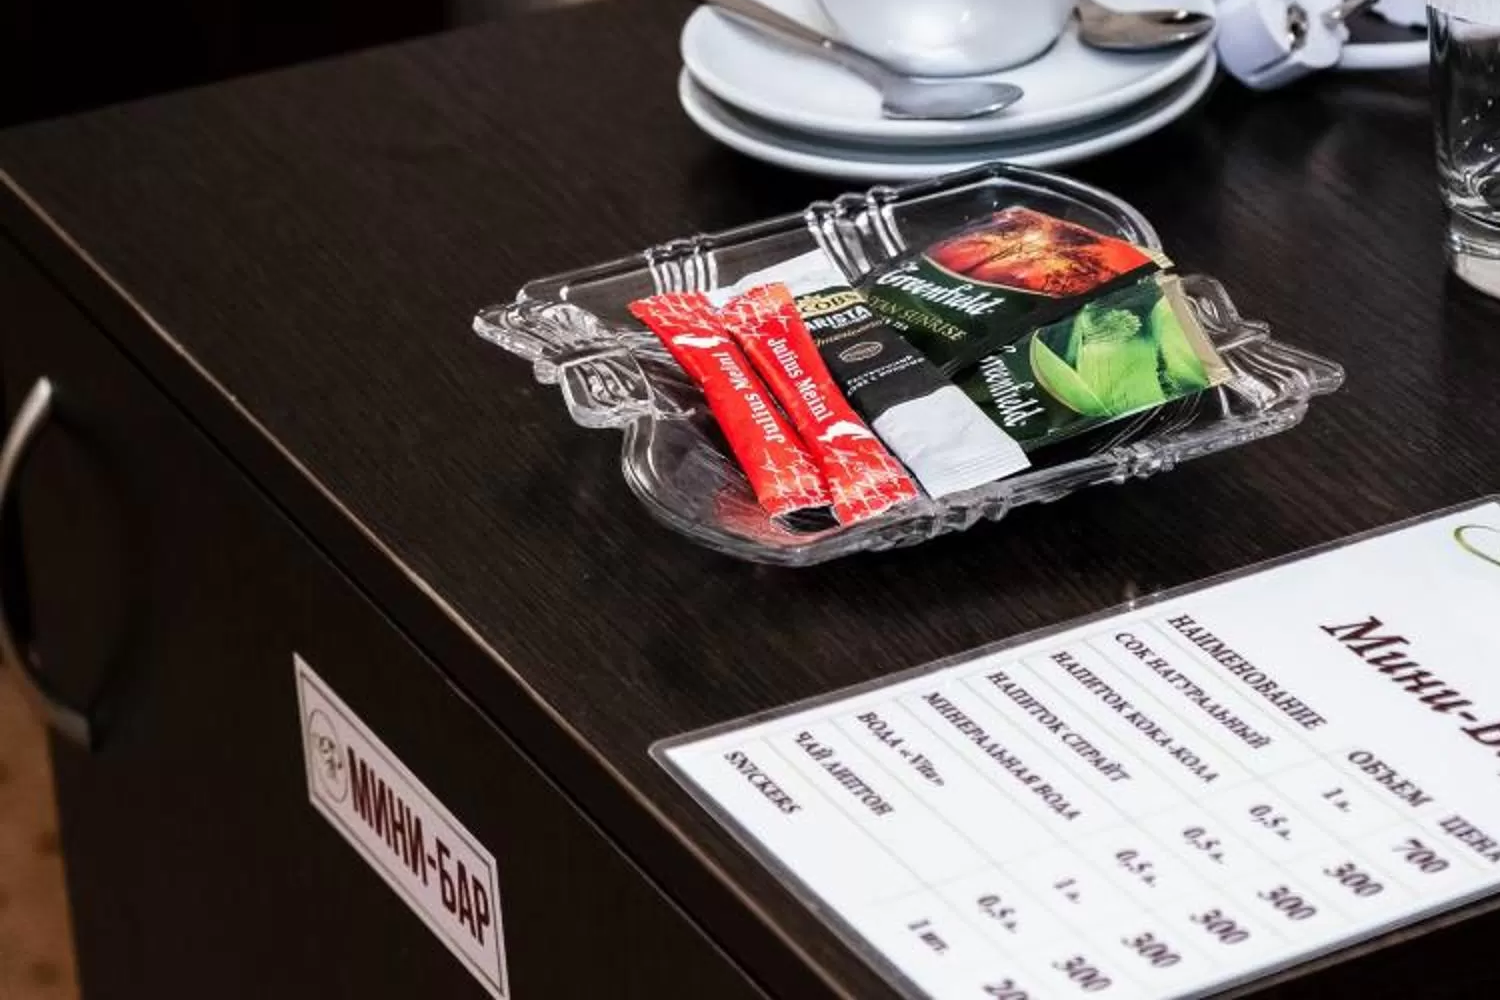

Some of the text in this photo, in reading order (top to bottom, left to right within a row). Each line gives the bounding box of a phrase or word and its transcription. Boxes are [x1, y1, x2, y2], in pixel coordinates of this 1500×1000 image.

[767, 337, 836, 422] Julius Meinl
[803, 305, 873, 331] ARISTA
[876, 261, 1006, 317] Greenfield
[980, 344, 1046, 427] reenfield
[711, 351, 787, 444] Julius Meinl
[724, 751, 801, 814] SNICKERS
[986, 671, 1069, 734] НАПИТОК
[1061, 733, 1130, 781] СПРАЙТ
[1258, 886, 1317, 920] 300
[1050, 651, 1133, 713] НАПИТОК
[1124, 712, 1218, 782] КОКА-КОЛА
[1324, 862, 1384, 896] 300
[1115, 633, 1155, 660] СОК
[1145, 658, 1271, 749] НАТУРАЛЬНЫЙ
[1399, 838, 1449, 873] 700
[1167, 614, 1327, 730] НАИМЕНОВАНИЕ
[1348, 751, 1433, 807] ОБЪЕМ
[347, 745, 490, 947] МИНИ-БАР
[795, 731, 833, 761] ЧАЙ
[822, 762, 893, 816] ЛИПТОН
[1053, 956, 1112, 991] 300
[857, 712, 904, 748] ВОДА
[1122, 932, 1181, 967] 300
[922, 692, 1041, 785] МИНЕРАЛЬНАЯ
[1032, 784, 1080, 820] ВОДА
[1190, 909, 1249, 944] 300
